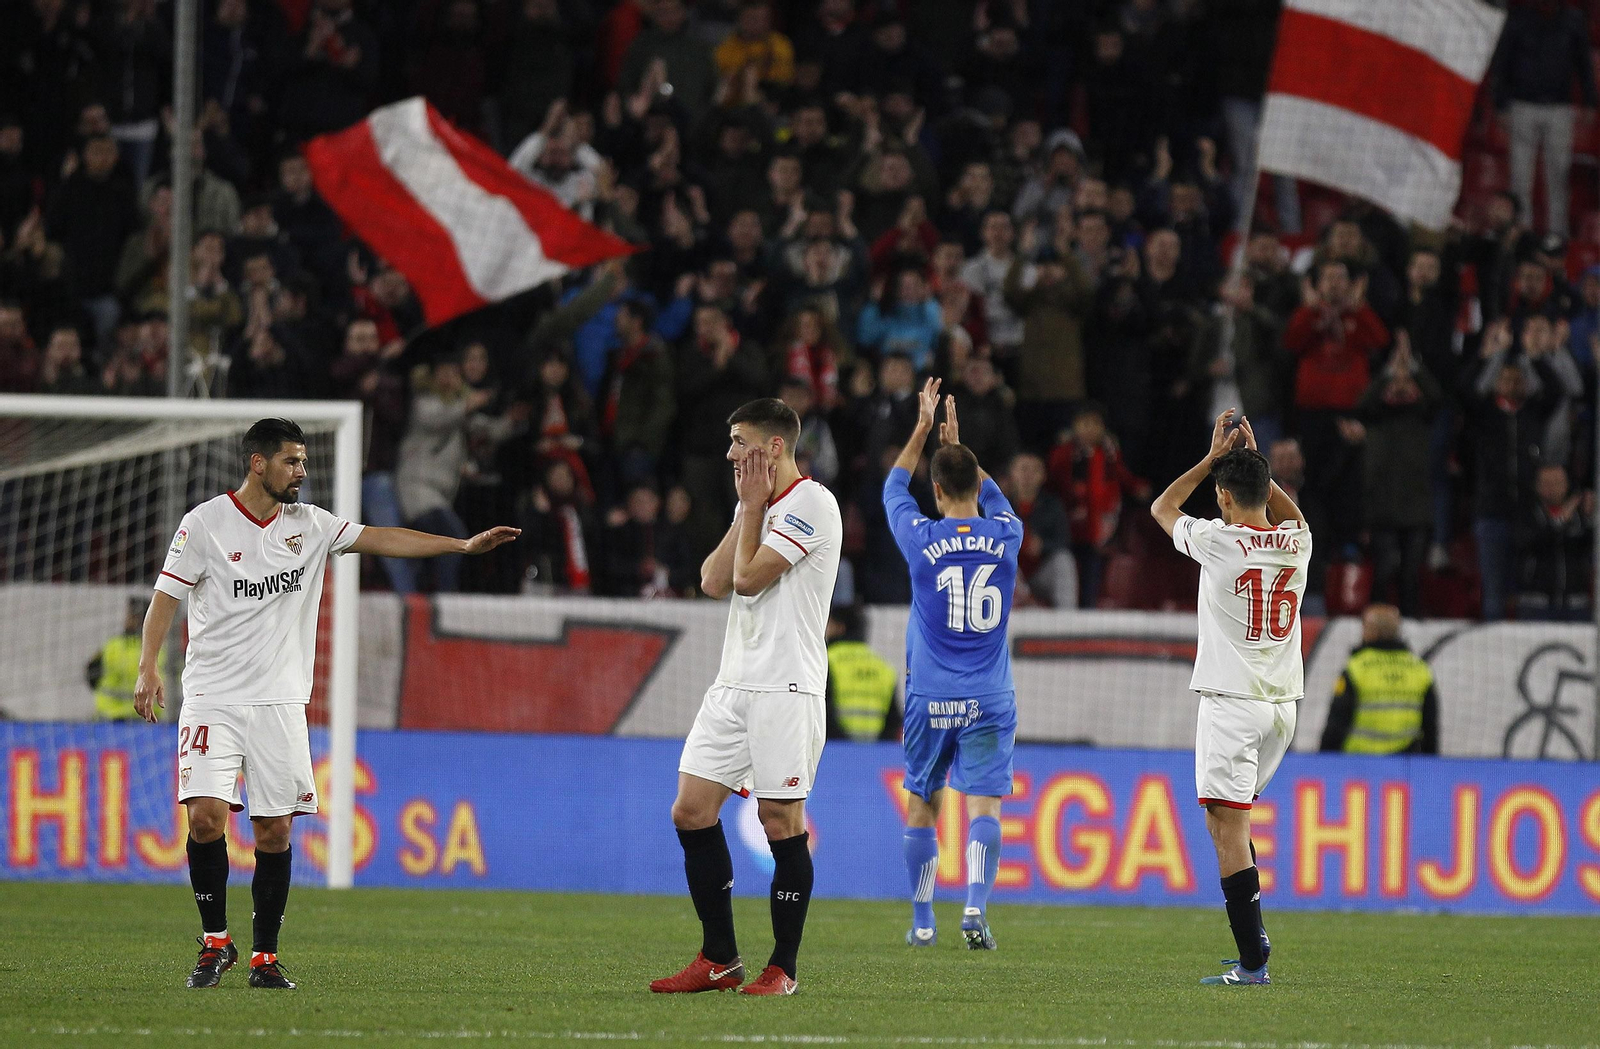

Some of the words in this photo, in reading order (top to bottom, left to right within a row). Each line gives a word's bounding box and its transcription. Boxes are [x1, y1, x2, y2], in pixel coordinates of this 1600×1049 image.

[923, 536, 963, 565] JUAN
[966, 535, 1005, 558] CALA
[1235, 533, 1300, 558] J.NAVAS
[233, 566, 305, 600] PlayWSOP
[937, 564, 1002, 633] 16
[1235, 568, 1298, 641] 16
[929, 701, 966, 715] GRANITOS
[179, 725, 210, 759] 24
[399, 799, 488, 878] SA
[195, 892, 213, 902] SFC
[776, 890, 801, 902] SFC
